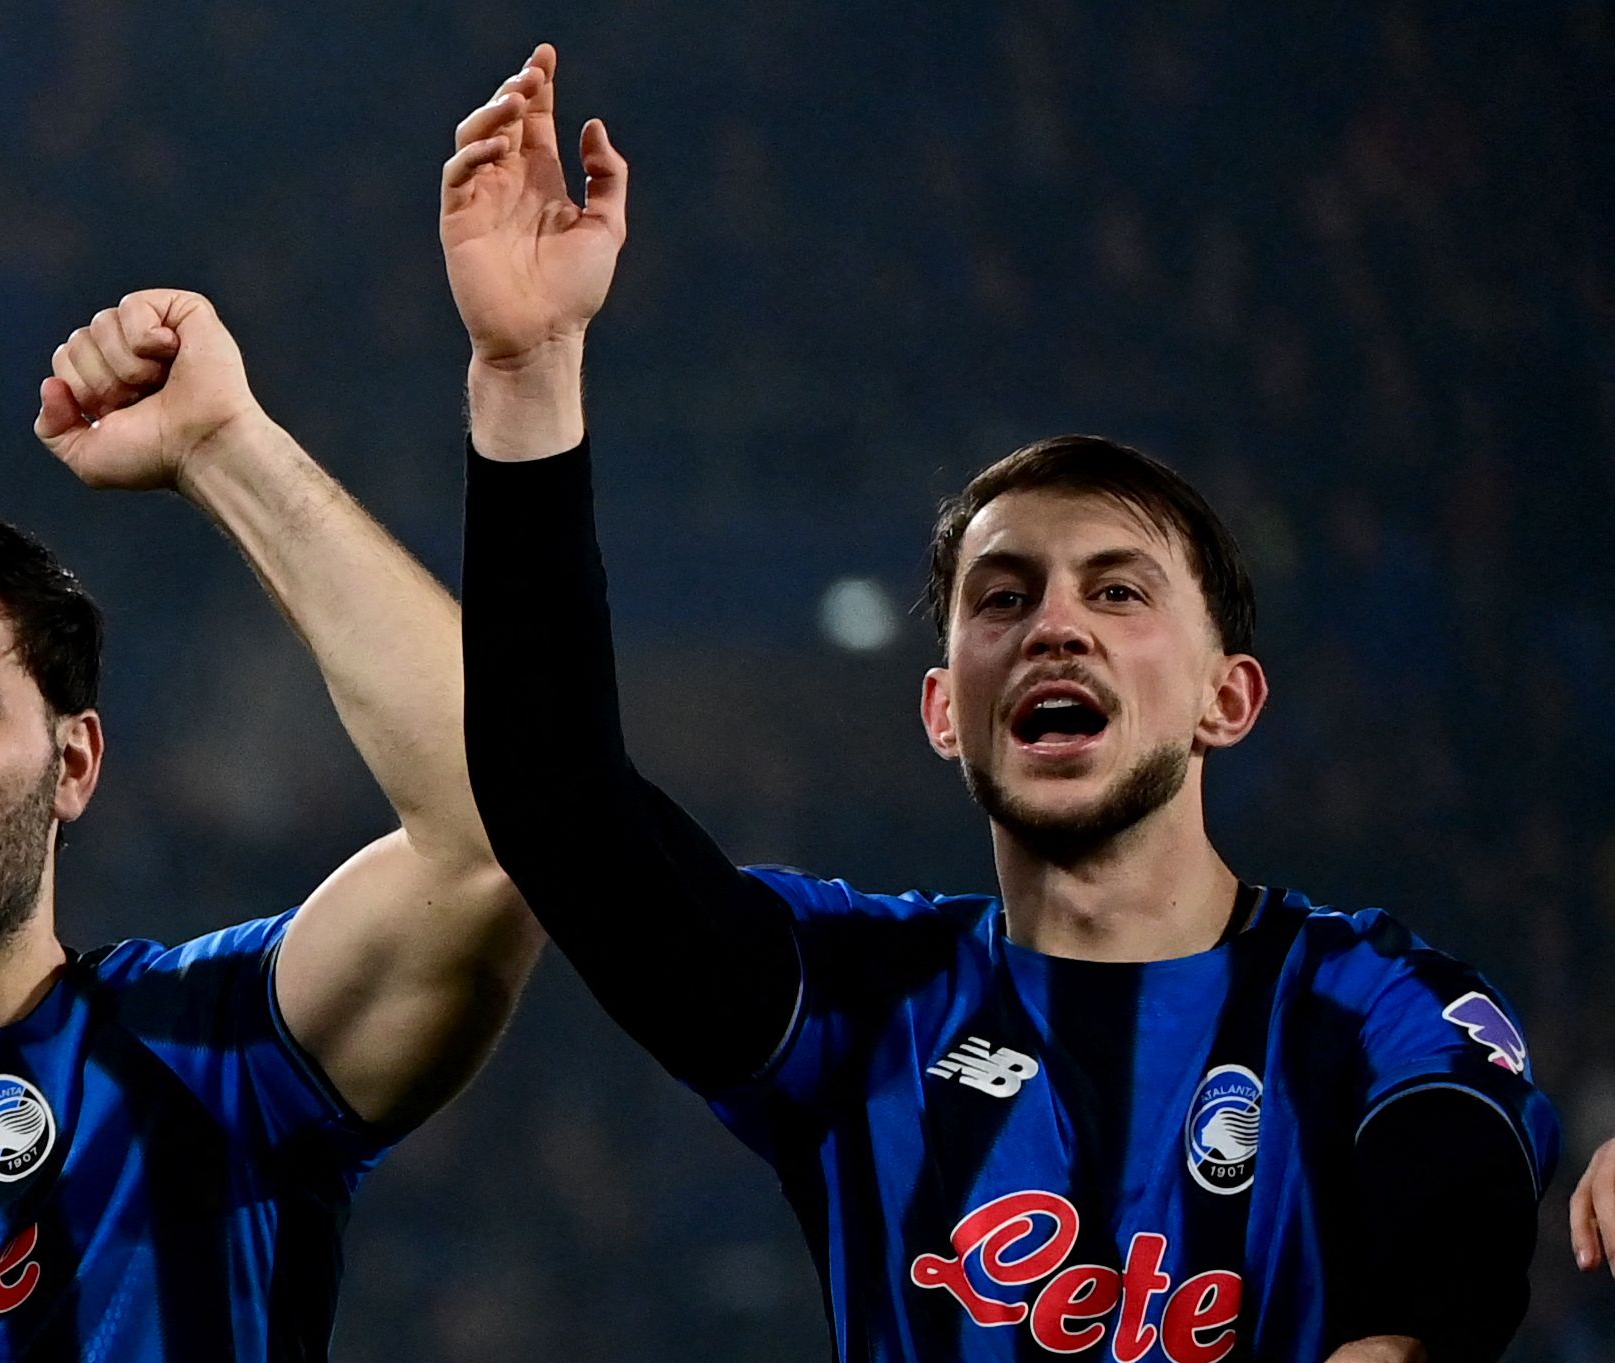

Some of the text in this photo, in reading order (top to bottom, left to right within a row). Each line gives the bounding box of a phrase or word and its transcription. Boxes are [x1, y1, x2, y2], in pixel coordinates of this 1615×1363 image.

[1200, 1084, 1258, 1103] ATALANTA
[7, 1146, 38, 1171] 1907
[1210, 1164, 1245, 1178] 1907
